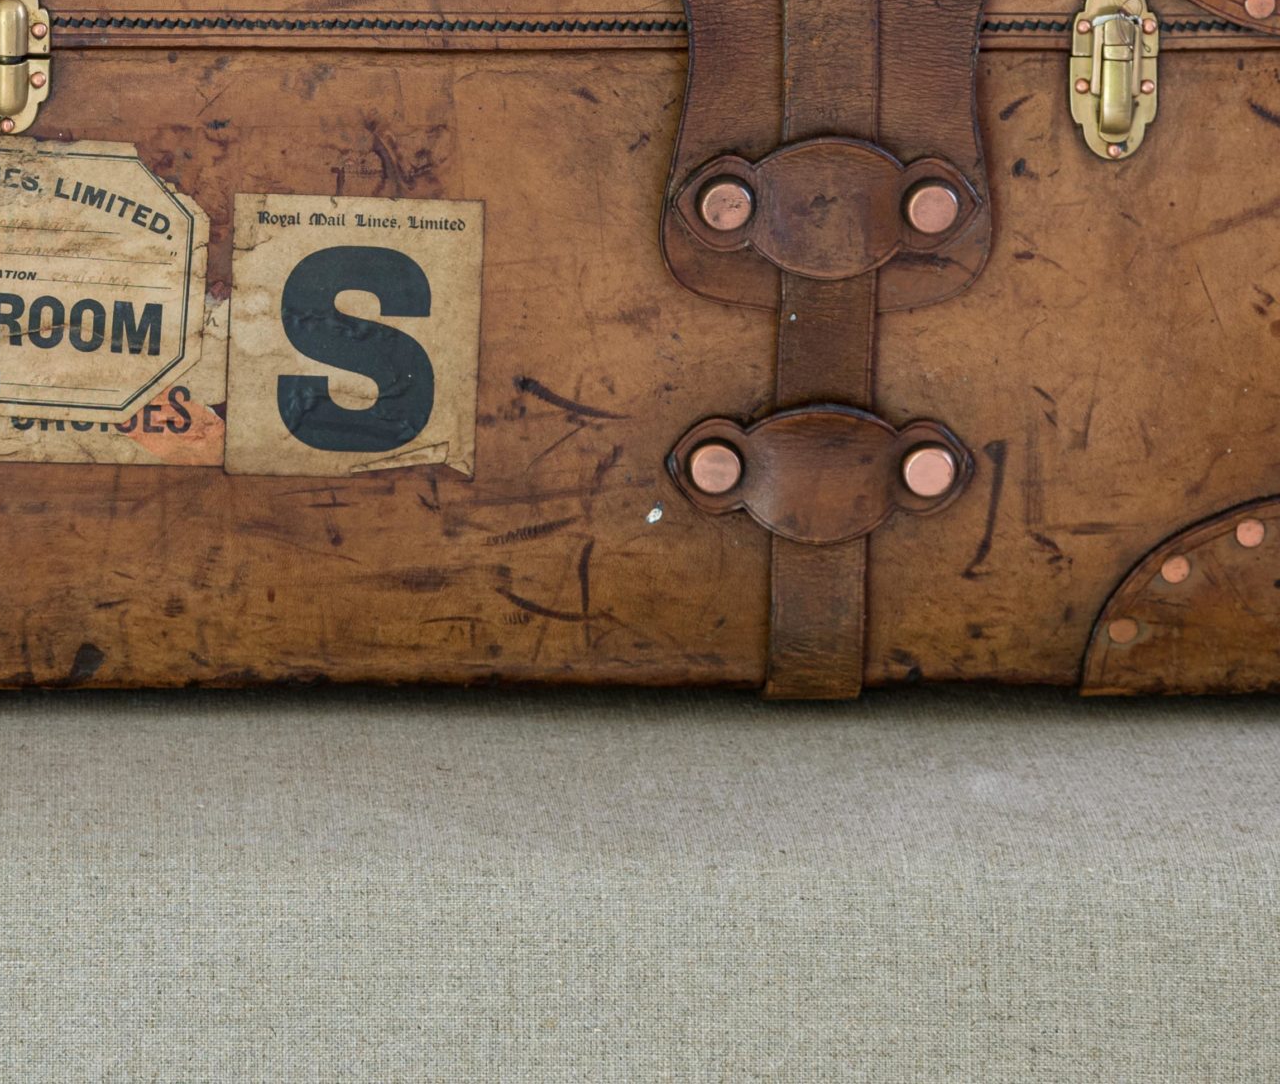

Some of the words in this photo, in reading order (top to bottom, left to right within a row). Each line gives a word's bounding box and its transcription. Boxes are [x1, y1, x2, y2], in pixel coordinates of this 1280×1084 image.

[54, 177, 173, 240] LIMITED.
[257, 211, 301, 228] Royal
[308, 212, 346, 227] Mail
[407, 215, 466, 232] Limited
[277, 245, 435, 453] S
